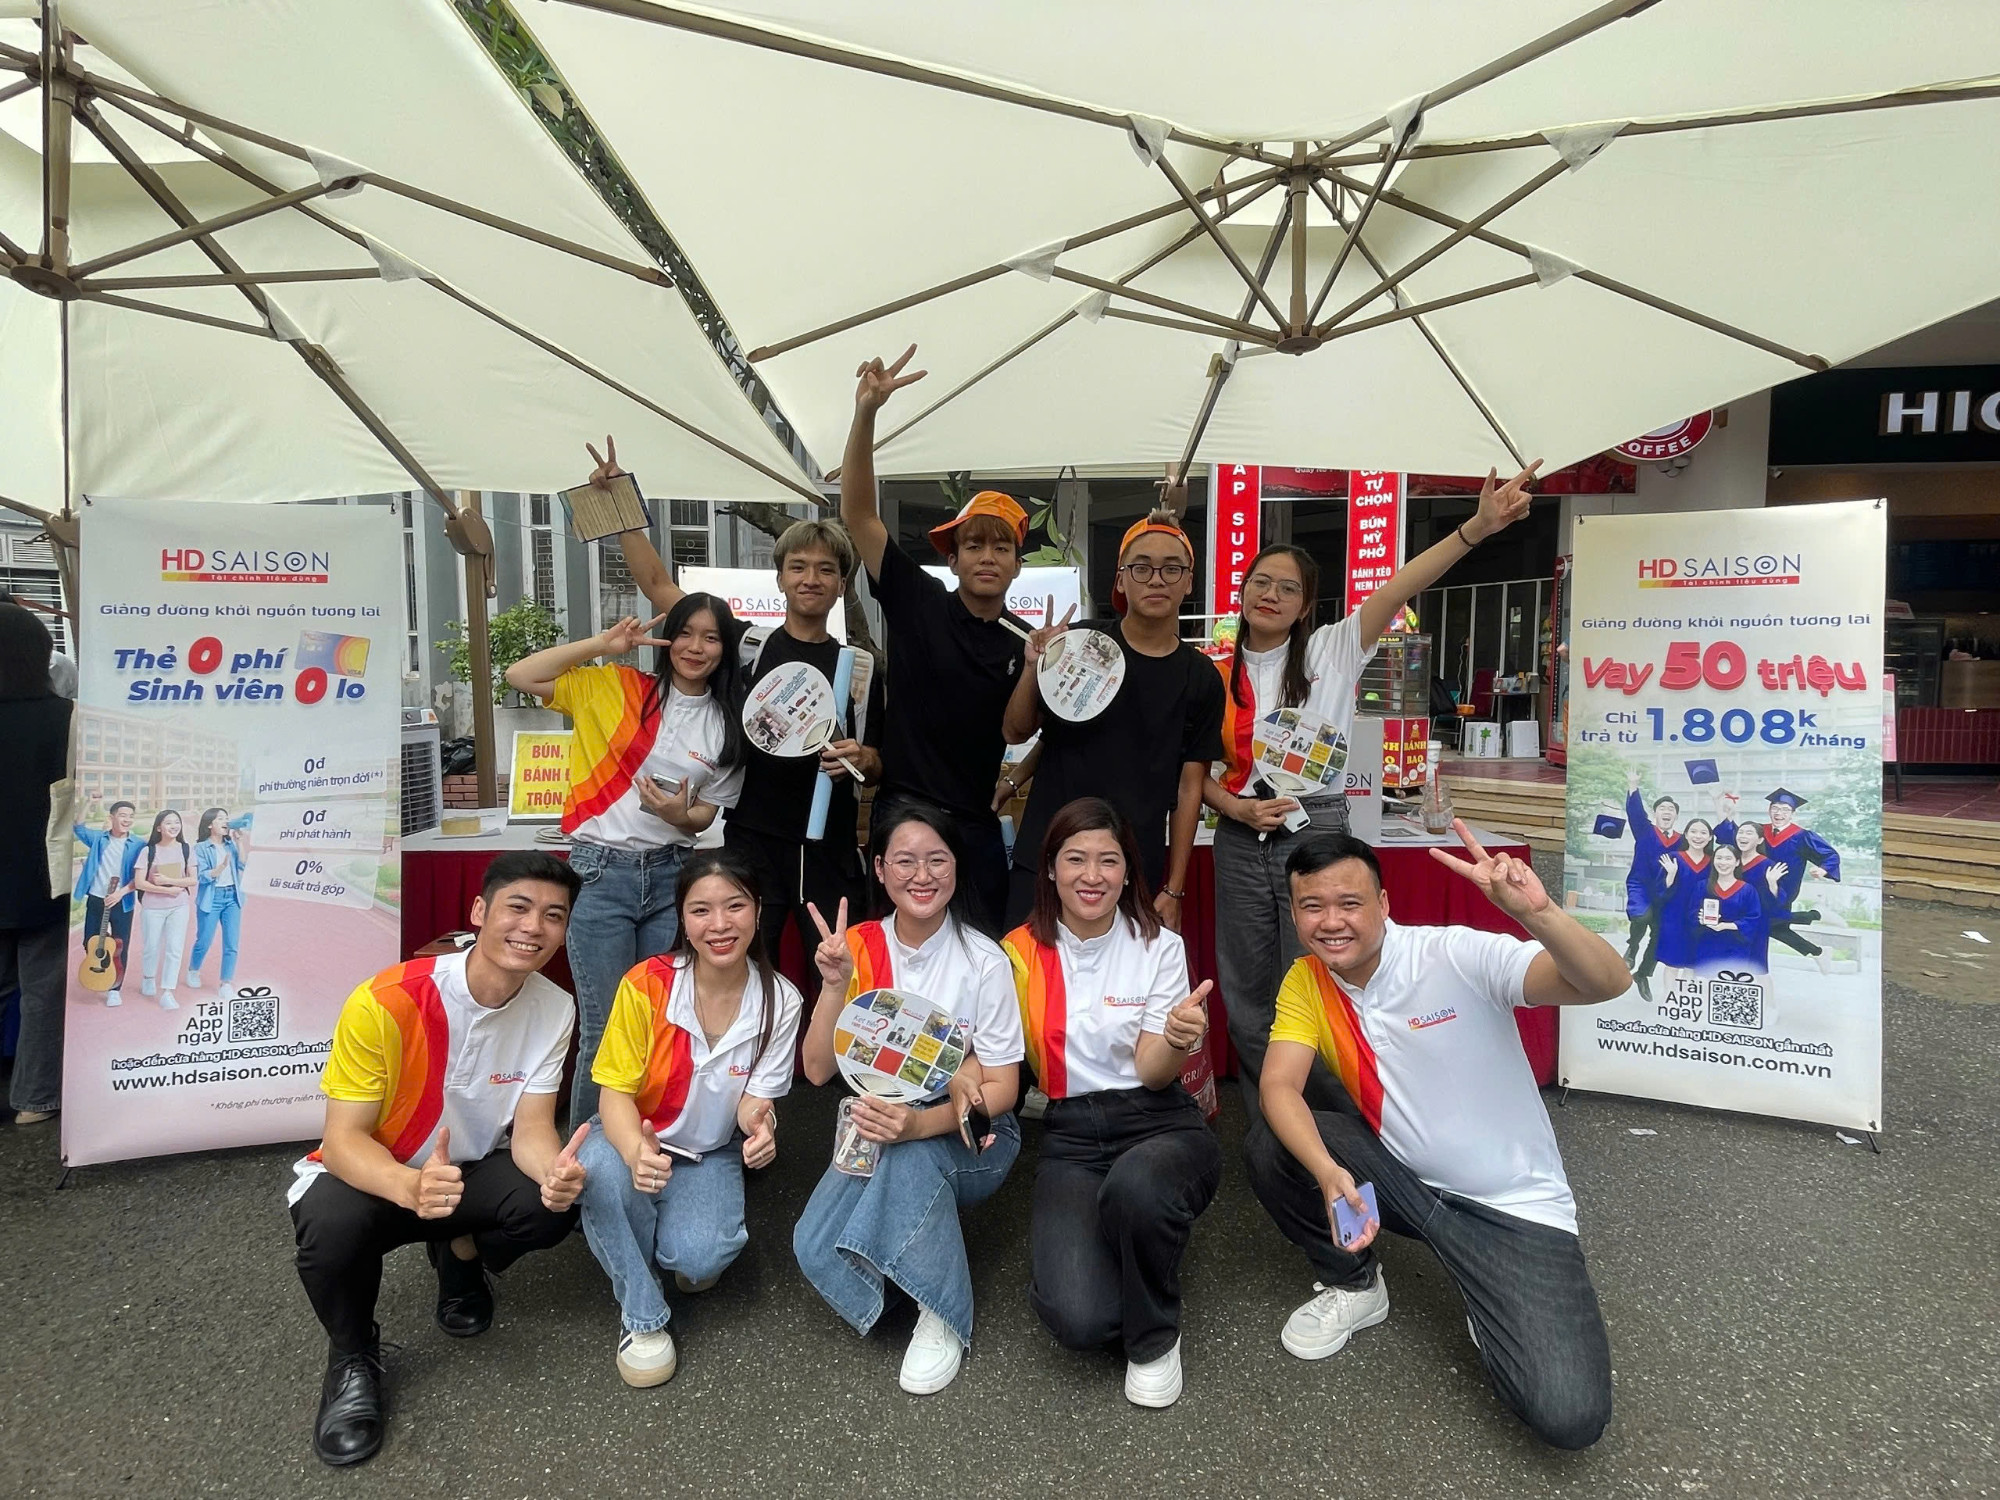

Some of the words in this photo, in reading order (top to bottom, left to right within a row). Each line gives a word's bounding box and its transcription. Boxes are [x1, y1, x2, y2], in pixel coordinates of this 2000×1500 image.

[1627, 435, 1692, 456] OFFEE
[1355, 492, 1393, 507] CHỌN
[1359, 514, 1388, 530] BÚN
[1358, 543, 1387, 559] PHỞ
[162, 549, 205, 571] HD
[211, 550, 329, 572] SAISON
[1638, 558, 1678, 579] HD
[1683, 553, 1801, 578] SAISON
[1351, 566, 1374, 579] BÁNH
[1375, 565, 1392, 578] XÈO
[1354, 580, 1373, 591] NEM
[100, 604, 151, 617] Giảng
[157, 603, 209, 617] đường
[215, 604, 250, 616] khởi
[256, 603, 306, 618] nguồn
[311, 606, 356, 618] tương
[361, 606, 381, 617] lai
[1581, 616, 1627, 630] Giảng
[1632, 616, 1682, 630] đường
[1688, 615, 1723, 628] khởi
[1730, 613, 1783, 629] nguồn
[1790, 615, 1842, 628] tương
[1848, 614, 1871, 625] lai
[114, 645, 177, 670] Thẻ
[187, 636, 223, 675] 0
[230, 647, 289, 674] phí
[1582, 657, 1653, 696] Vay
[1659, 640, 1747, 691] 50
[1757, 654, 1867, 698] triệu
[127, 676, 204, 701] Sinh
[215, 679, 284, 700] viên
[294, 665, 328, 705] 0
[336, 678, 366, 699] lo
[1605, 711, 1638, 725] Chỉ
[1403, 740, 1427, 751] BÁNH
[1581, 730, 1611, 743] trả
[1618, 730, 1638, 744] từ
[531, 742, 564, 760] BÚN,
[1406, 755, 1424, 765] BAO
[523, 766, 561, 782] BÁNH
[259, 782, 273, 794] phí
[274, 779, 307, 791] thường
[308, 776, 328, 788] niên
[330, 776, 350, 787] trọn
[280, 829, 295, 840] phí
[296, 828, 320, 840] phát
[322, 828, 351, 839] hành
[295, 860, 323, 876] 0%
[269, 878, 281, 888] lãi
[282, 879, 305, 891] suất
[306, 880, 321, 892] trả
[321, 882, 345, 897] góp
[1675, 978, 1704, 995] Tải
[1665, 991, 1703, 1008] App
[196, 1001, 223, 1016] Tải
[1420, 1006, 1456, 1024] SAISON
[1657, 1005, 1703, 1022] ngay
[185, 1017, 223, 1033] App
[177, 1030, 223, 1046] ngay
[1597, 1018, 1624, 1032] hoặc
[1624, 1021, 1648, 1034] đến
[1648, 1023, 1670, 1037] cửa
[1671, 1026, 1701, 1041] hàng
[1702, 1030, 1722, 1042] HD
[1722, 1033, 1774, 1049] SAISON
[1774, 1038, 1801, 1053] gần
[1801, 1042, 1834, 1057] nhất
[112, 1057, 141, 1072] hoặc
[142, 1053, 166, 1067] đến
[167, 1050, 190, 1065] cửa
[190, 1050, 221, 1065] hàng
[222, 1048, 241, 1061] HD
[242, 1045, 288, 1060] SAISON
[288, 1041, 310, 1057] gần
[311, 1039, 333, 1053] nhấ
[1598, 1036, 1832, 1079] www.hdsaison.com.vn
[112, 1061, 327, 1091] www.hdsaison.com.v
[244, 1099, 260, 1109] phí
